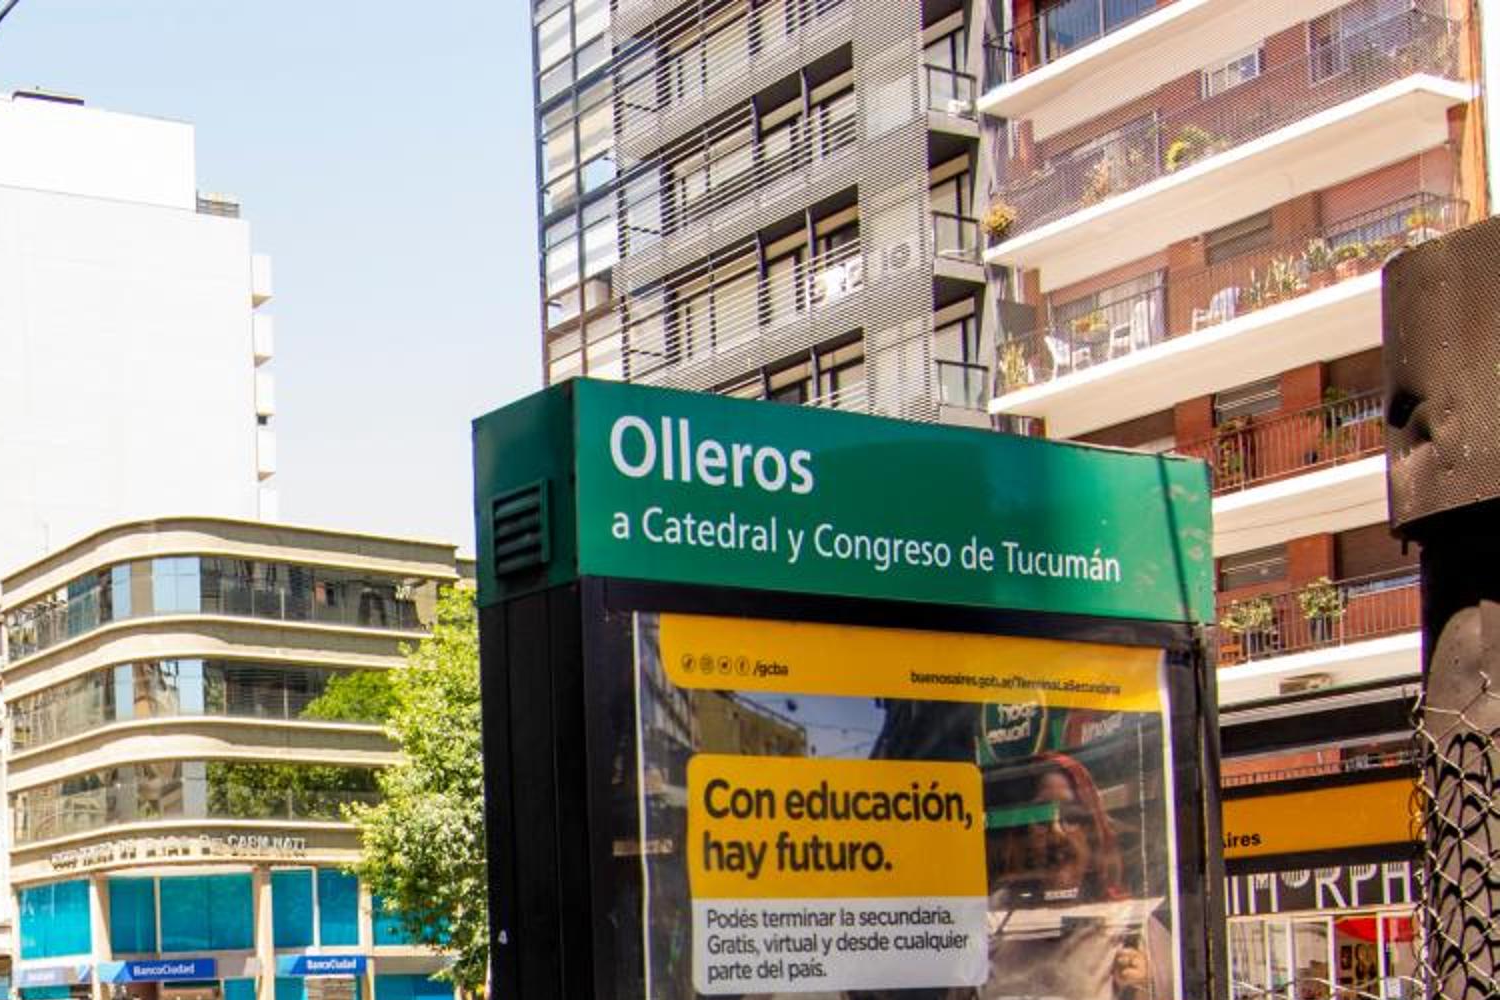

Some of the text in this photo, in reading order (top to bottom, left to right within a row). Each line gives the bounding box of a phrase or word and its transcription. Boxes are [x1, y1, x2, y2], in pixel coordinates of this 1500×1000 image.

[610, 415, 814, 494] Olleros
[611, 506, 1122, 582] a Catedral y Congreso de Tucumán
[704, 778, 972, 830] Con educación,
[703, 830, 892, 880] hay futuro.
[707, 906, 955, 928] Podés terminar la secundaria.
[707, 930, 969, 956] Gratis, virtual y desde cualquier
[133, 963, 195, 976] BancoCiudad
[307, 957, 357, 970] BancoCiudad
[708, 958, 827, 984] parte del país.
